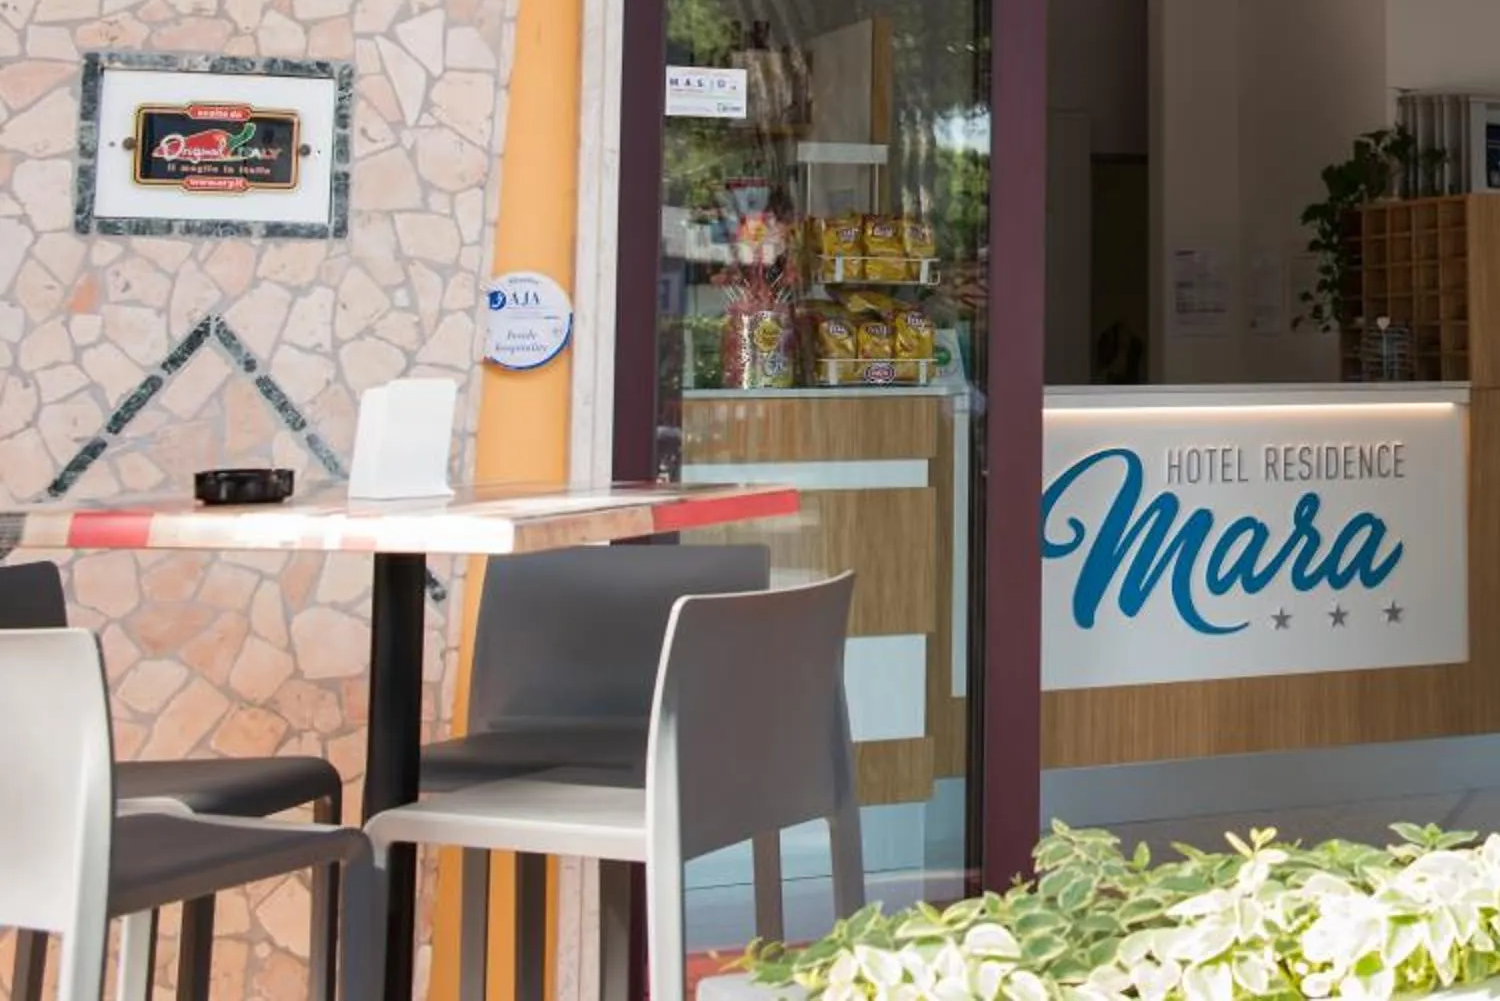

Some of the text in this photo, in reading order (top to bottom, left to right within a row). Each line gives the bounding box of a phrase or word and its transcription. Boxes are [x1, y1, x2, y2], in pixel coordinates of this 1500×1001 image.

[1166, 442, 1406, 484] HOTEL RESIDENCE
[1041, 447, 1404, 636] Mara
